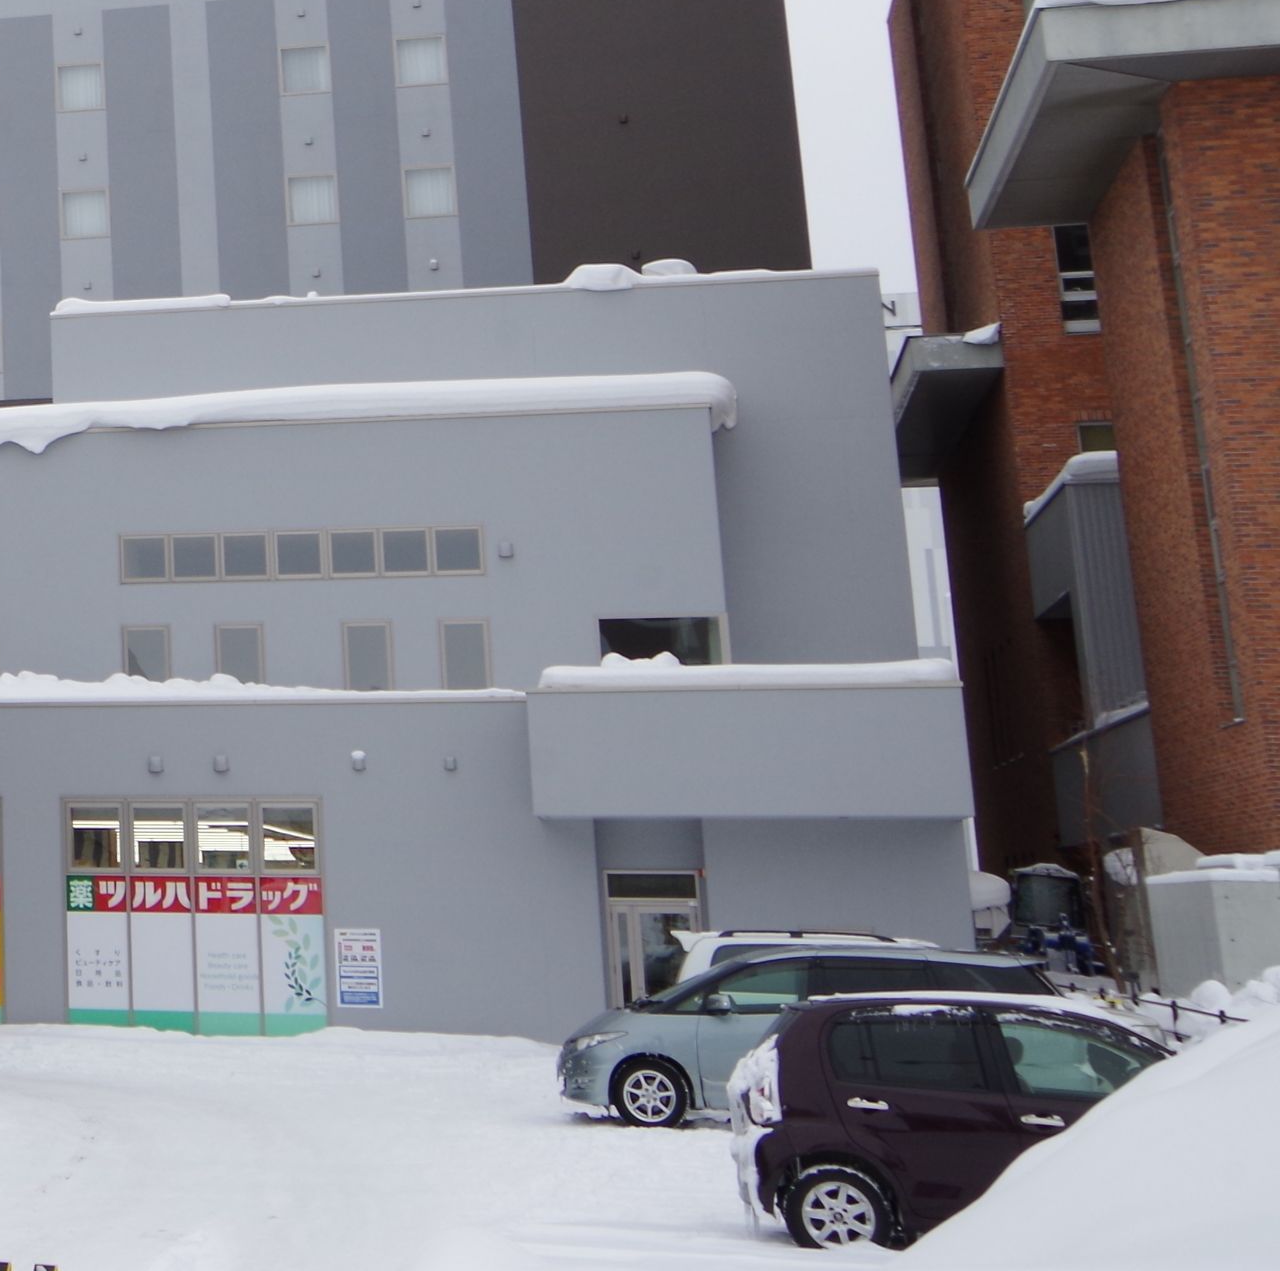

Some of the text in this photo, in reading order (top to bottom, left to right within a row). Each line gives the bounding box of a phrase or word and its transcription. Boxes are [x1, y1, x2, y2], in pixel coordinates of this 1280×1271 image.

[70, 879, 319, 911] 薬 ツルハドラッグ
